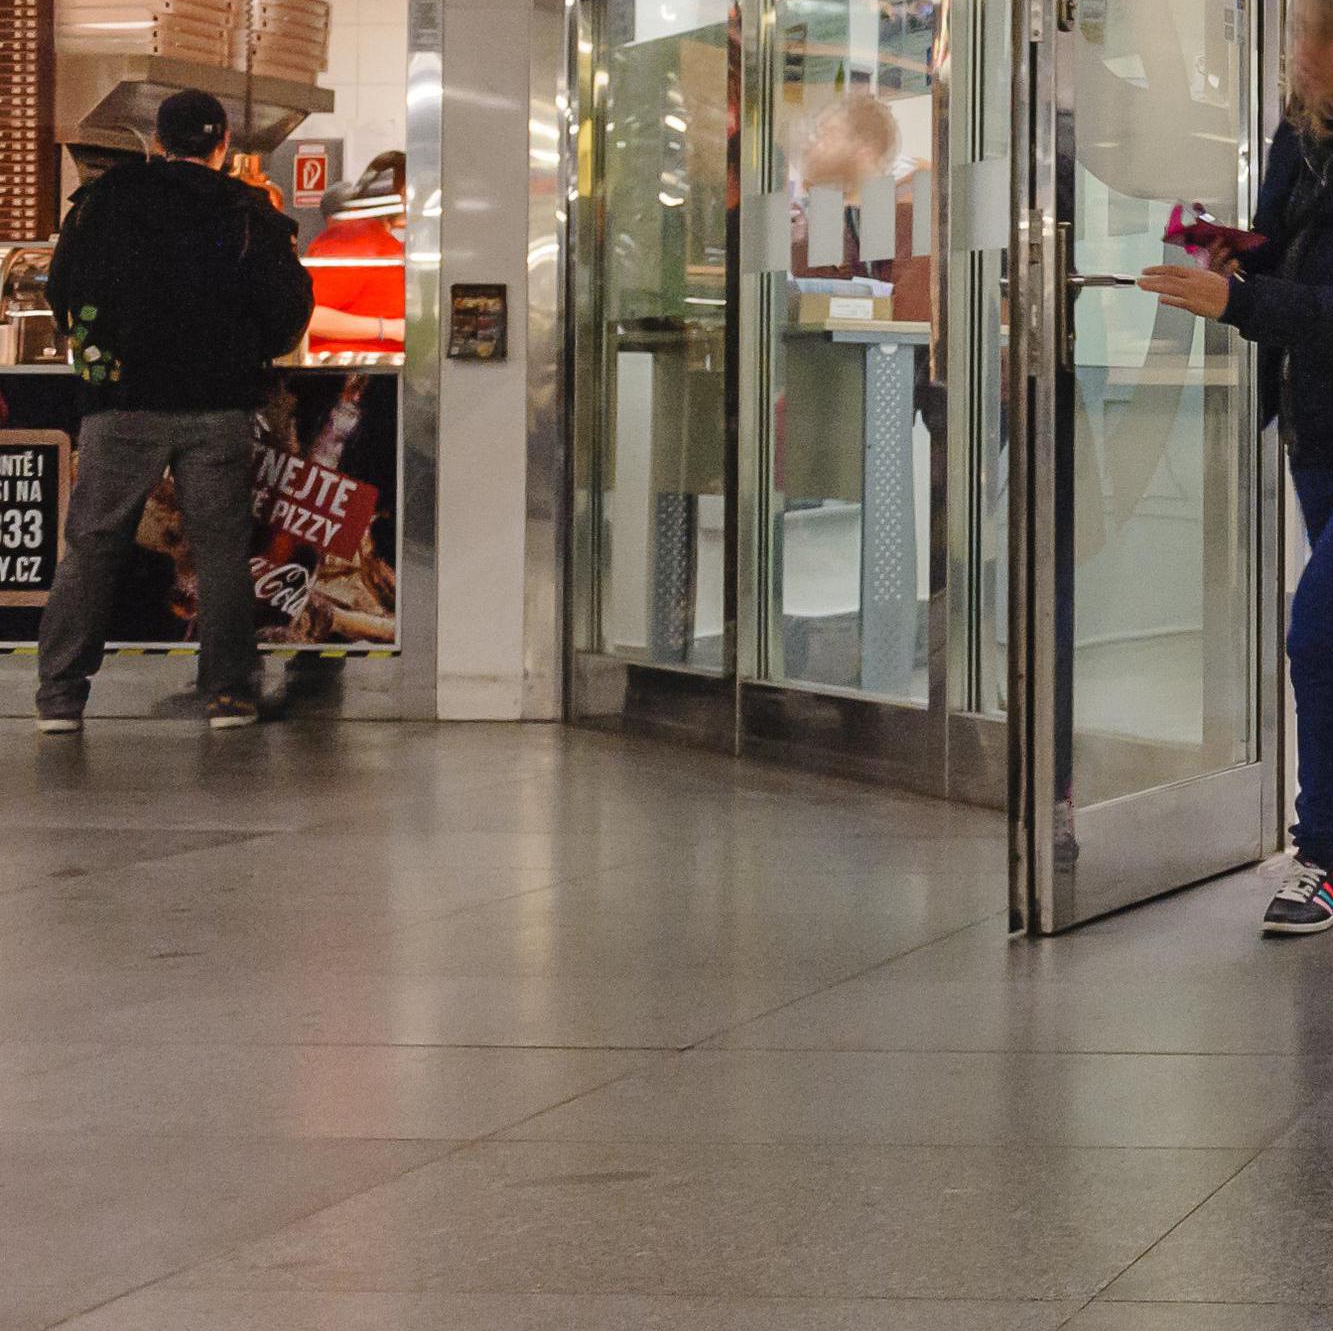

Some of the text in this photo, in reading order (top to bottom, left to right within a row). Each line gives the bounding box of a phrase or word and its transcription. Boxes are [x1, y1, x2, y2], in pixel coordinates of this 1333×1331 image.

[16, 480, 42, 502] NA
[0, 509, 43, 549] 33
[271, 500, 342, 549] PIZZY
